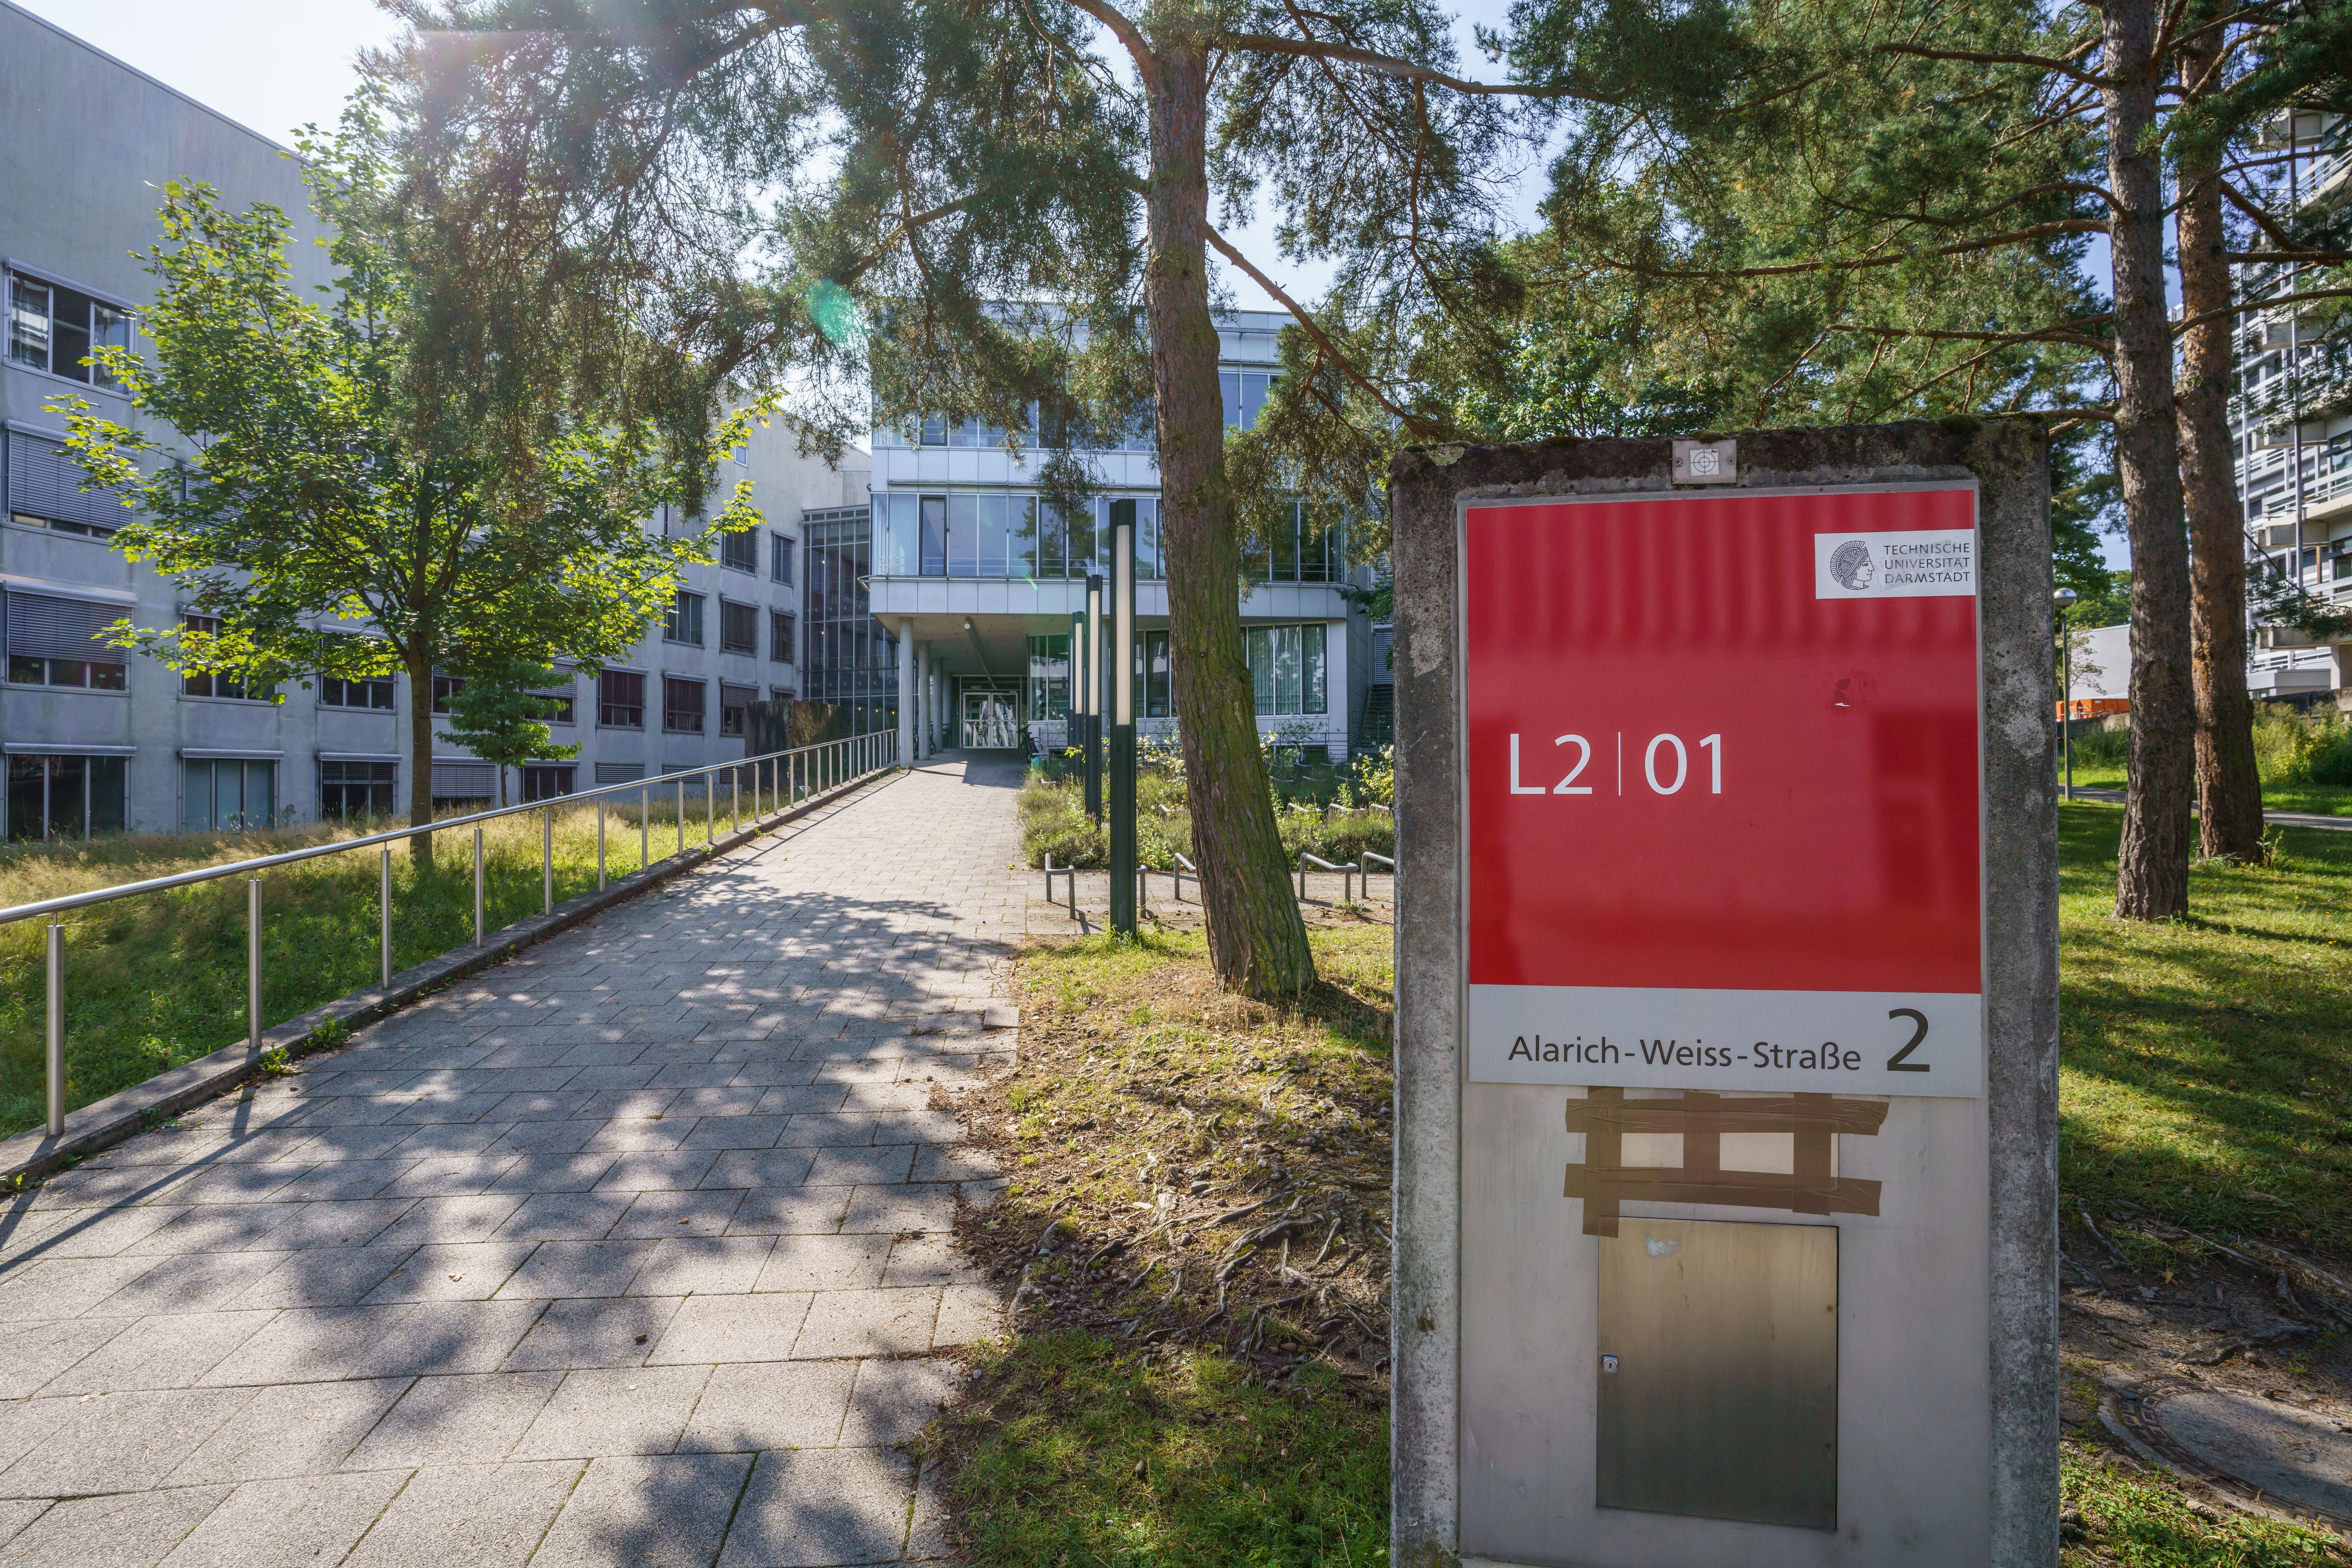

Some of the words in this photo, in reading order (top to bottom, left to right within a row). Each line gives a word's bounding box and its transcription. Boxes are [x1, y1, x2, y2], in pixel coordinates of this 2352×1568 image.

[1884, 543, 1970, 555] TECHNISCHE
[1885, 557, 1970, 569] UNIVERSITÄT
[1885, 572, 1970, 584] DARMSTADT
[1510, 733, 1592, 794] L2
[1645, 733, 1721, 795] 01
[1508, 1034, 1862, 1071] Alarich-Weiss-Straße
[1887, 1008, 1930, 1072] 2
